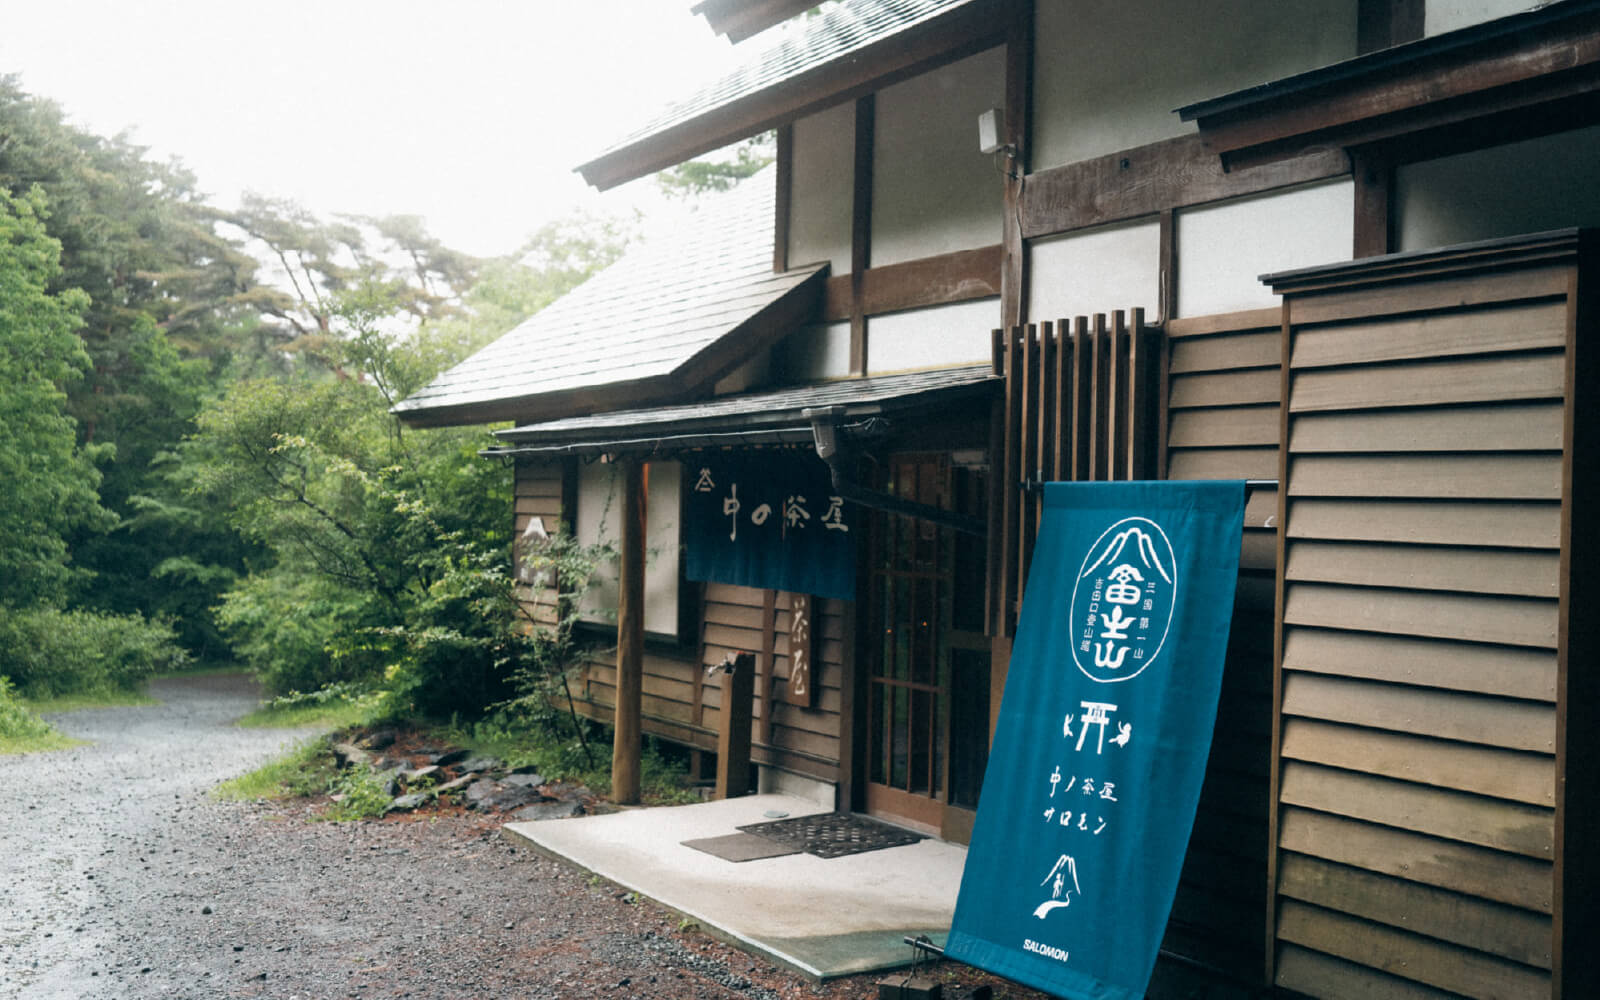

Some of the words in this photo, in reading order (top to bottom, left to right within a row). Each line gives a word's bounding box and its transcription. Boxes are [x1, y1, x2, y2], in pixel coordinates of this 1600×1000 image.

[723, 483, 848, 542] 中の茶屋
[1049, 765, 1118, 802] 中ノ茶屋
[1043, 807, 1106, 835] サロモン
[1022, 938, 1069, 963] SALOMON
